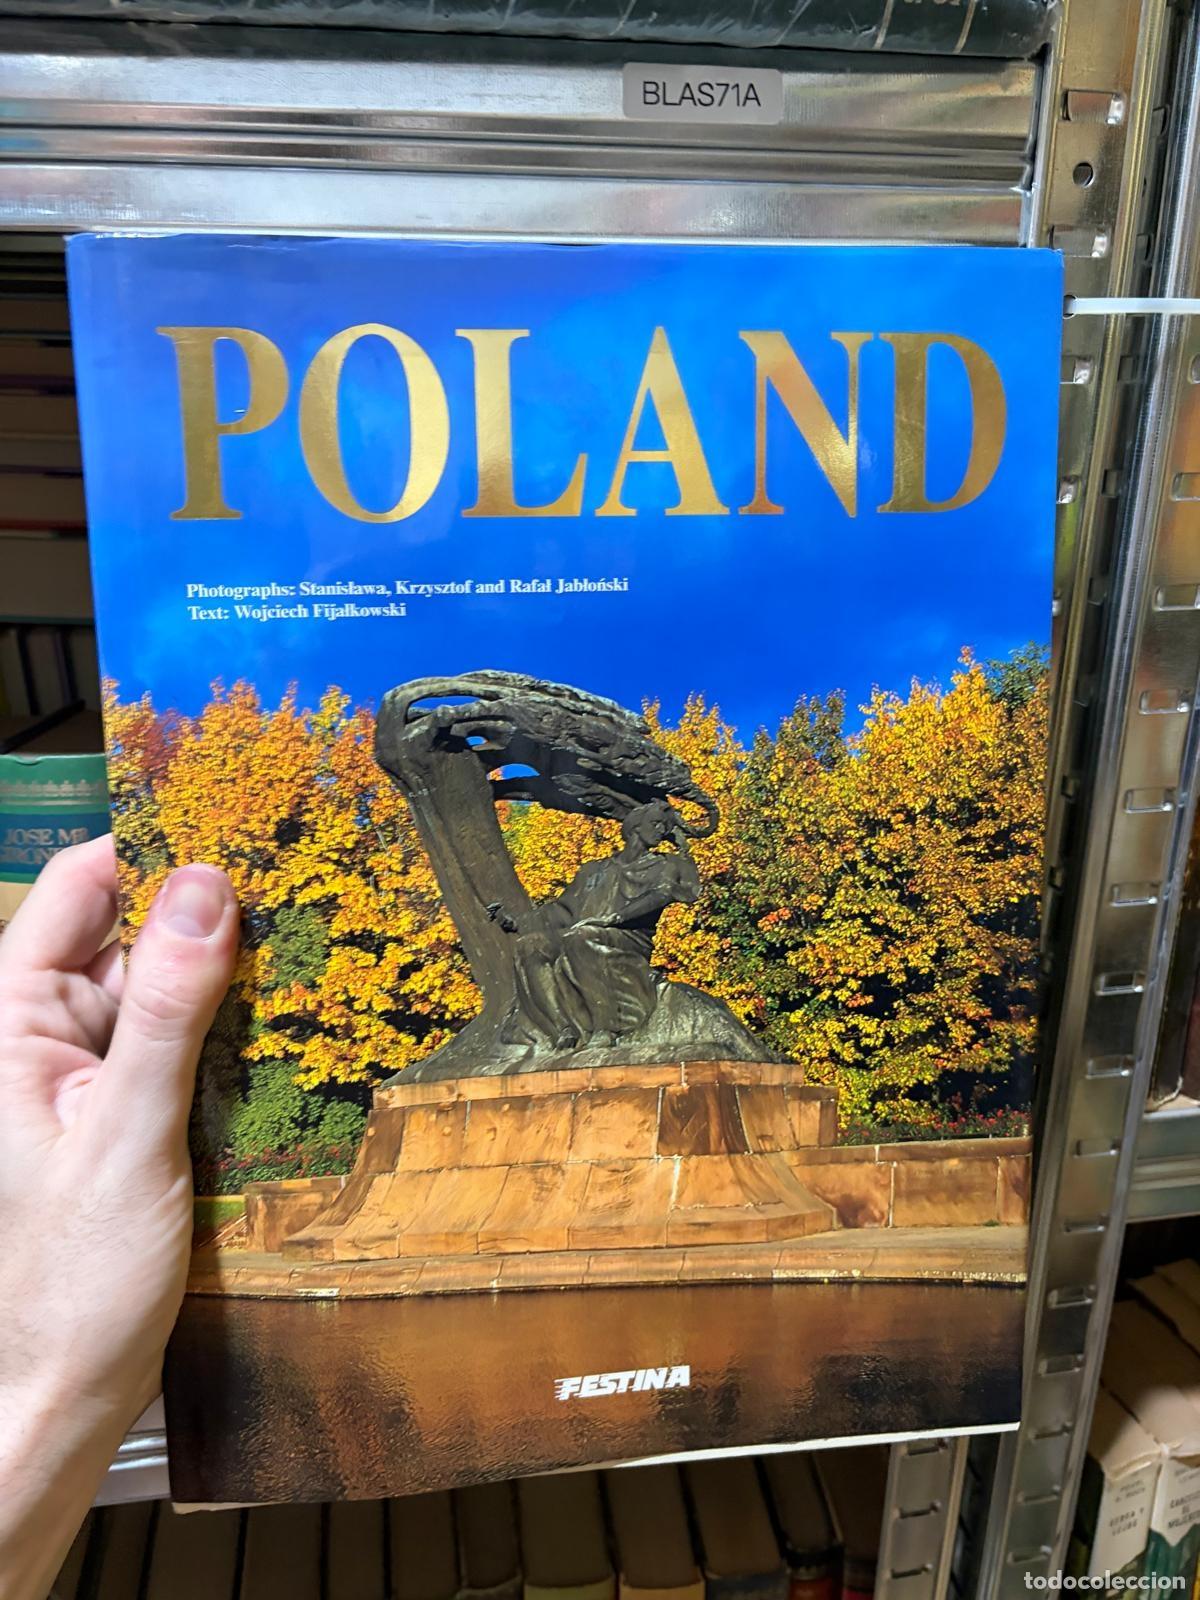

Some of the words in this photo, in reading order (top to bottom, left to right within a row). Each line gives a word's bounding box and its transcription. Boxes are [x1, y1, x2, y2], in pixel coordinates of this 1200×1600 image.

[642, 80, 762, 108] BLAS71A
[156, 322, 1009, 524] POLAND
[186, 582, 297, 601] Photographs:
[299, 580, 393, 598] Stanisława,
[395, 579, 473, 598] Krzysztof
[475, 579, 505, 594] and
[509, 578, 552, 593] Rafał
[554, 576, 629, 594] Jabłoński
[188, 604, 230, 620] Text:
[234, 604, 309, 622] Wojciech
[554, 1365, 690, 1401] FESTINA
